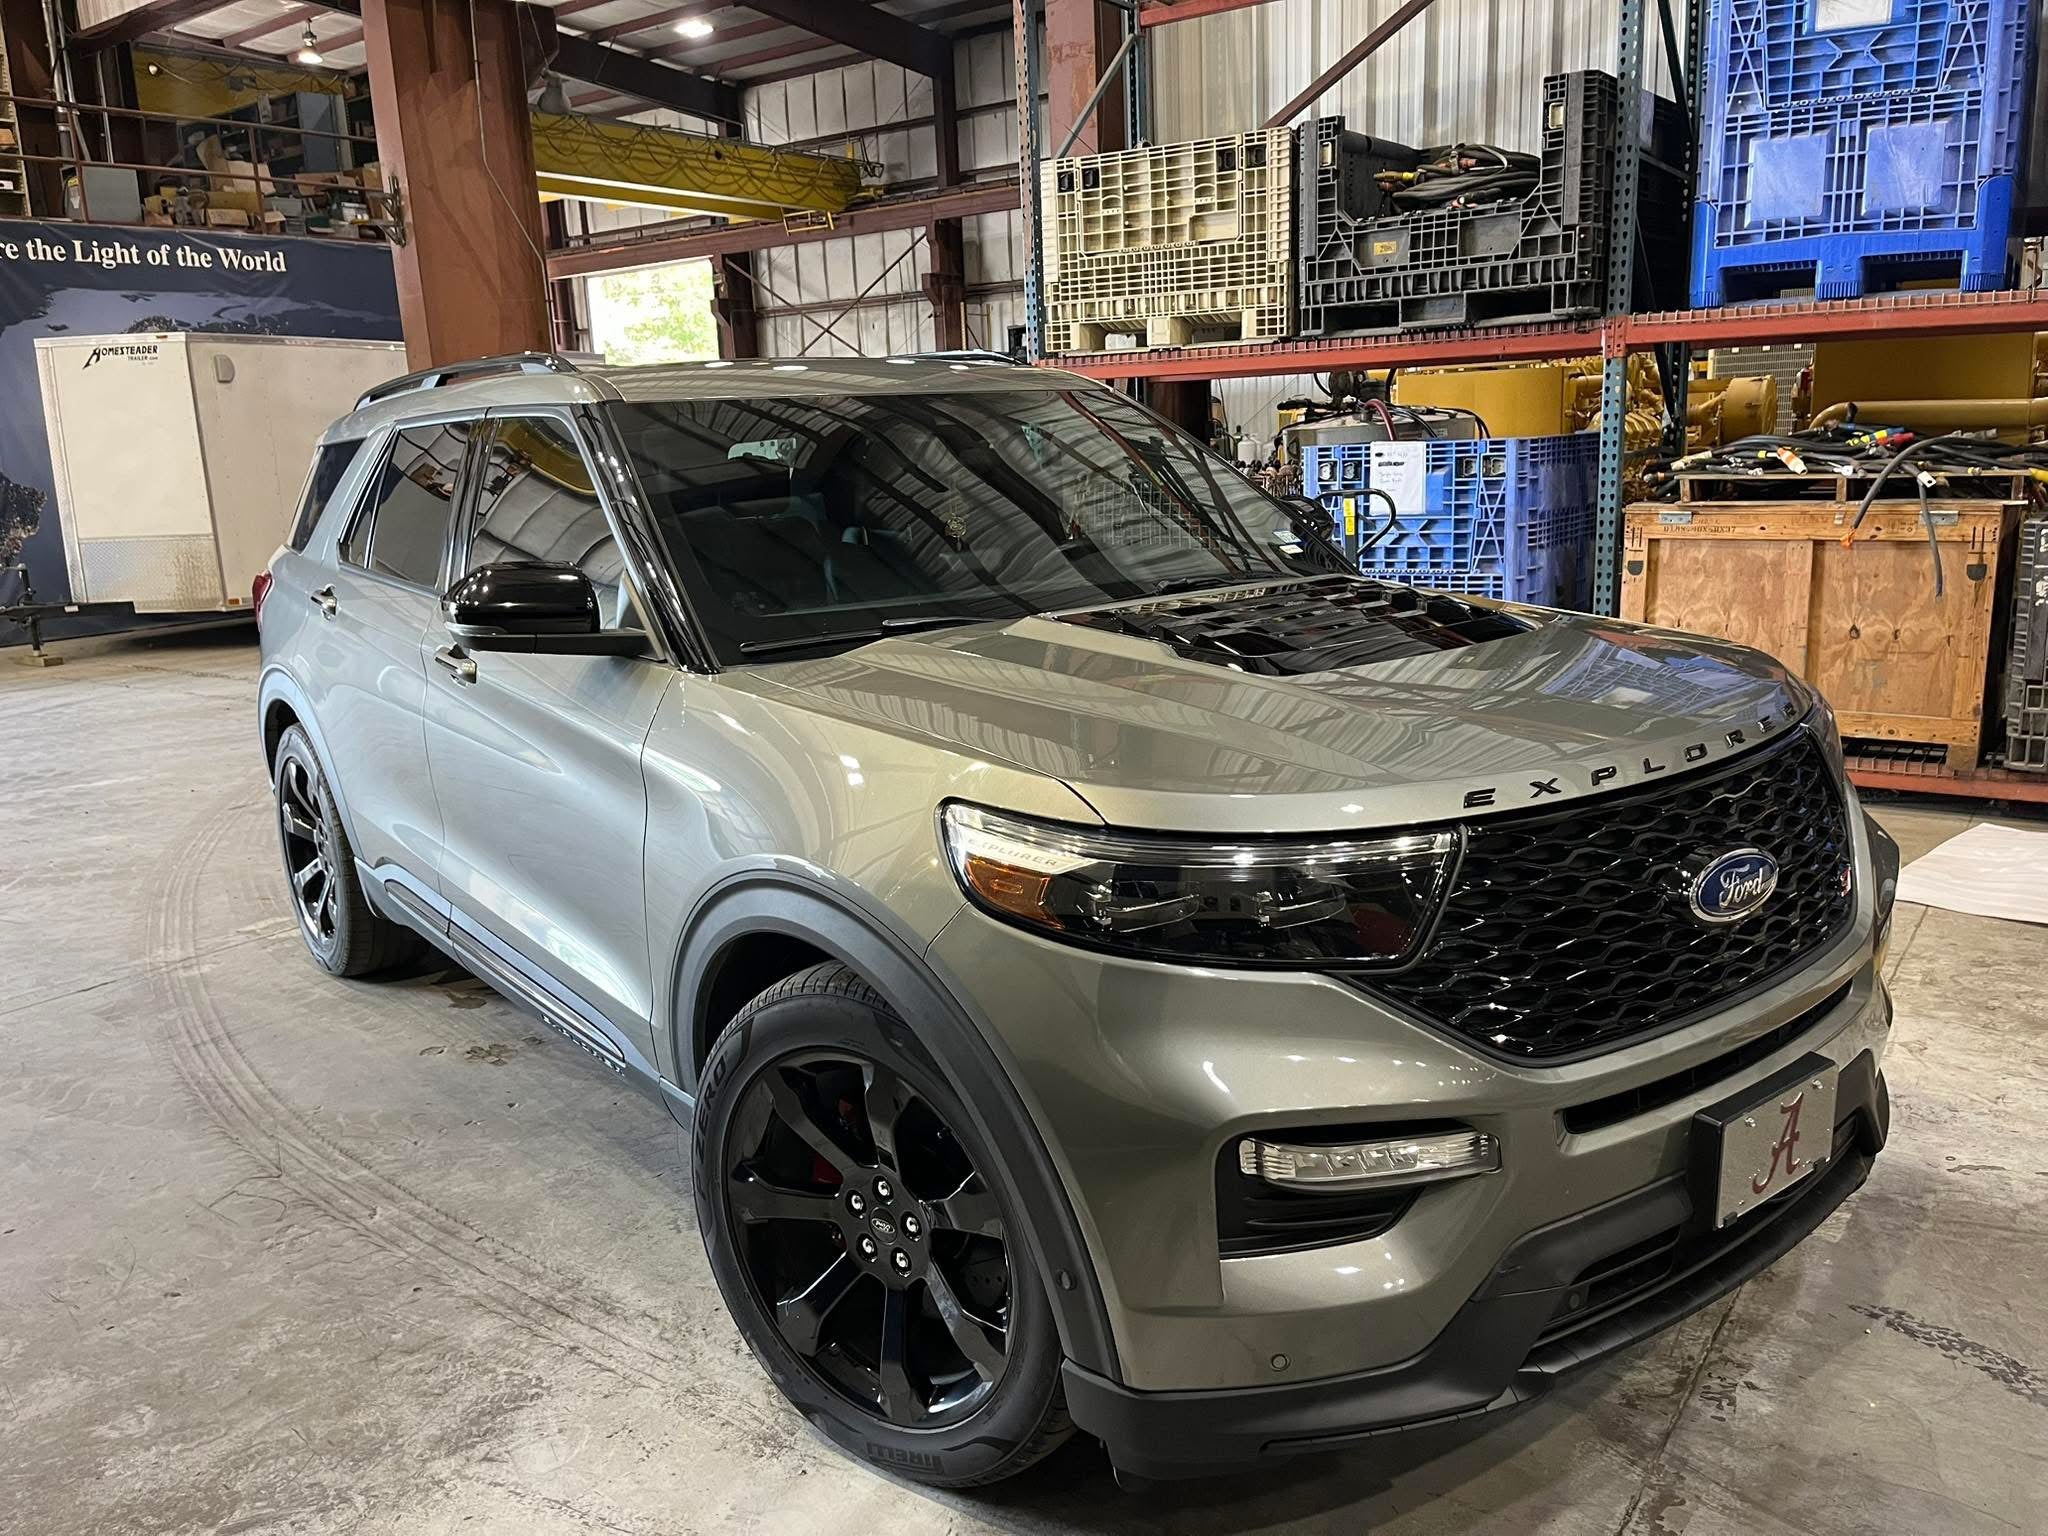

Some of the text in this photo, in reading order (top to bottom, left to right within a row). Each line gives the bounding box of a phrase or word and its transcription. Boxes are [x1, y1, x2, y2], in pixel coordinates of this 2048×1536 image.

[26, 238, 67, 262] the
[72, 240, 141, 269] Light
[147, 244, 170, 266] of
[176, 246, 213, 268] the
[216, 247, 287, 272] World
[82, 344, 159, 370] HOMESTEADER
[1463, 702, 1797, 809] EXPLORER
[1718, 863, 1767, 909] Ford
[1752, 1091, 1804, 1195] A
